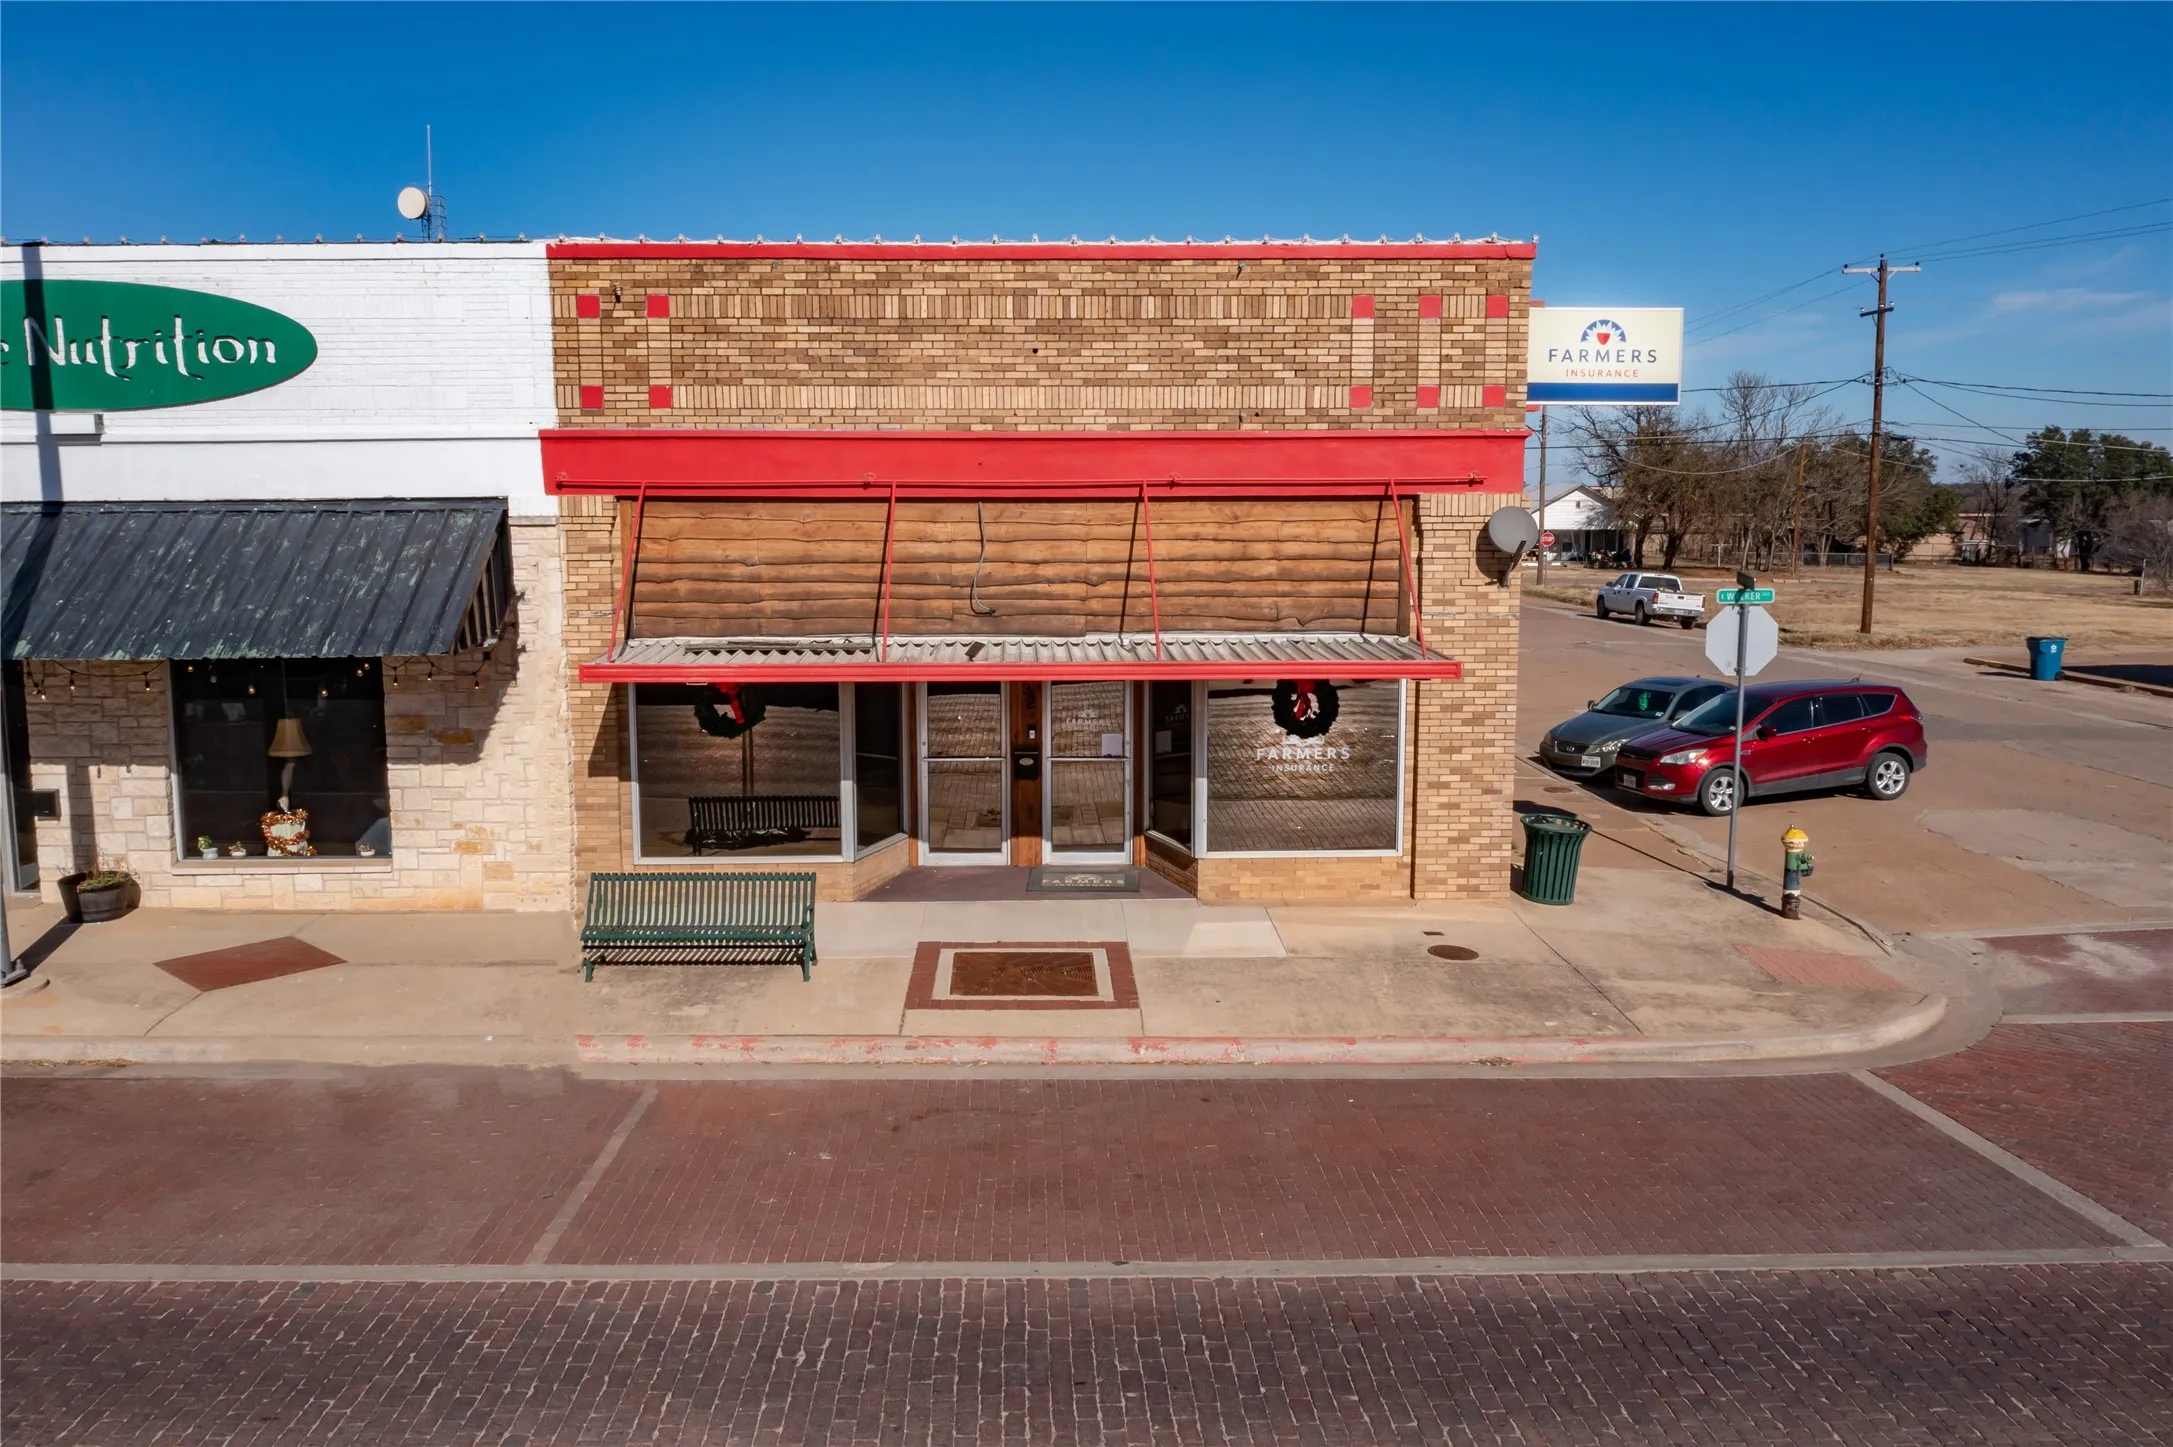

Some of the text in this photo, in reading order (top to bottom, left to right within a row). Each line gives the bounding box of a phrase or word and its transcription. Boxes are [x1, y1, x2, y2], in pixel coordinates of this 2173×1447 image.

[23, 315, 276, 381] Nutrition
[1549, 348, 1657, 363] FARMERS
[1566, 369, 1639, 378] INSURANCE
[1726, 591, 1761, 600] WLKER
[1255, 747, 1351, 761] FARMERS
[1271, 763, 1335, 772] INSURANCE
